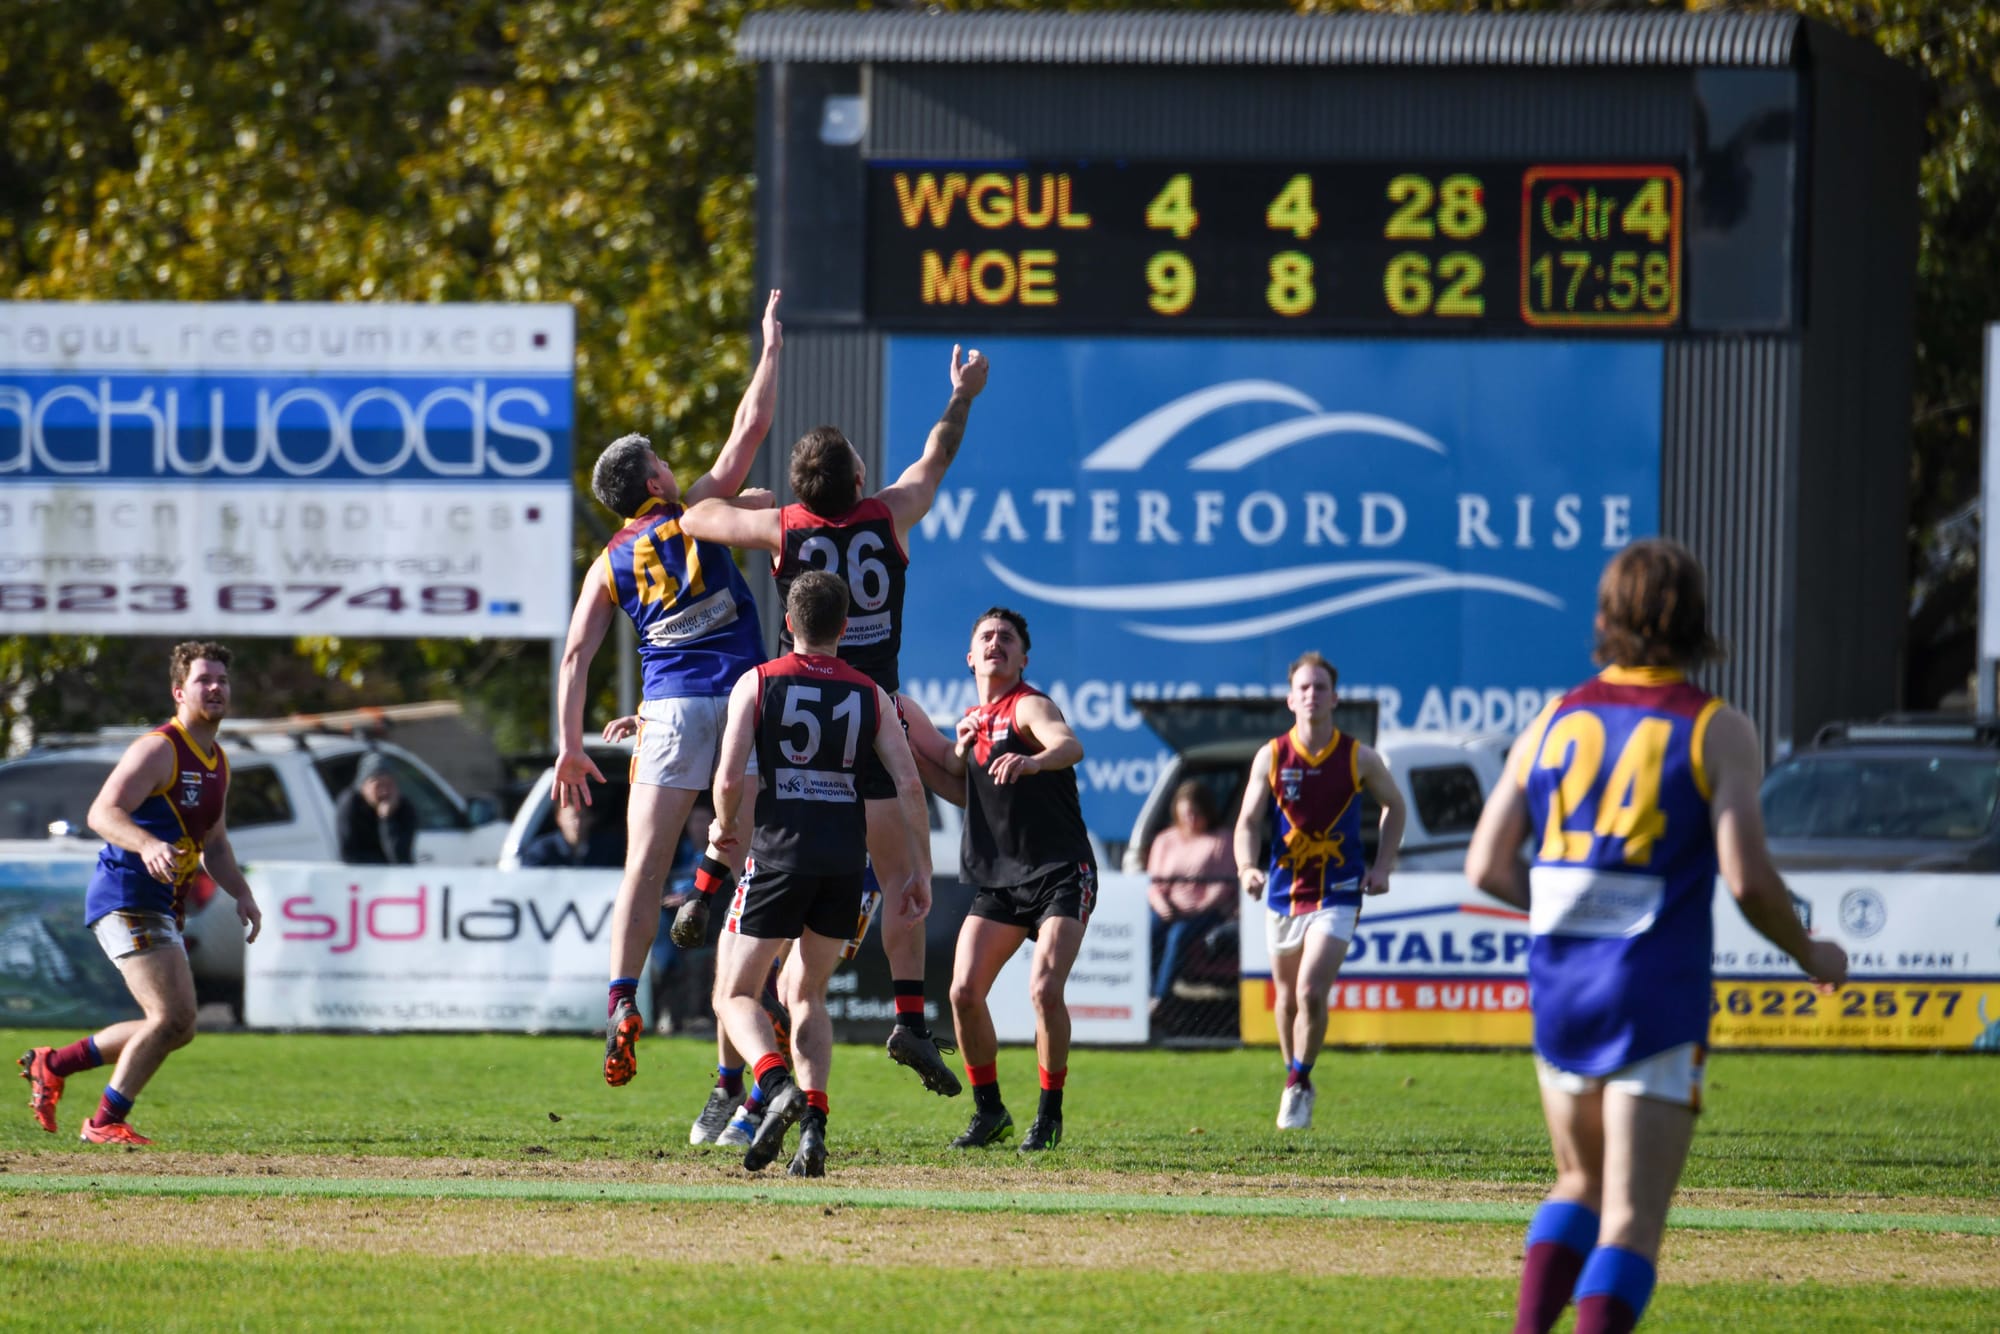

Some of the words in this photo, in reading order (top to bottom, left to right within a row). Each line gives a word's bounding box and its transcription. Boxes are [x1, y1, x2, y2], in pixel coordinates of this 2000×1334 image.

[1145, 173, 1200, 240] 4
[1266, 173, 1320, 240] 4
[1384, 173, 1487, 240] 28
[921, 249, 1059, 306] MOE
[1145, 250, 1197, 317] 9
[1266, 250, 1317, 317] 8
[1383, 250, 1486, 317] 62
[1531, 250, 1671, 310] 17:58
[919, 488, 1408, 546] WATERFORD
[1456, 493, 1633, 550] RISE
[633, 518, 706, 609] 47
[216, 582, 481, 615] 6749
[779, 685, 861, 768] 51
[1538, 710, 1674, 866] 24
[1898, 952, 1953, 968] SPAN
[1843, 990, 1963, 1018] 2577
